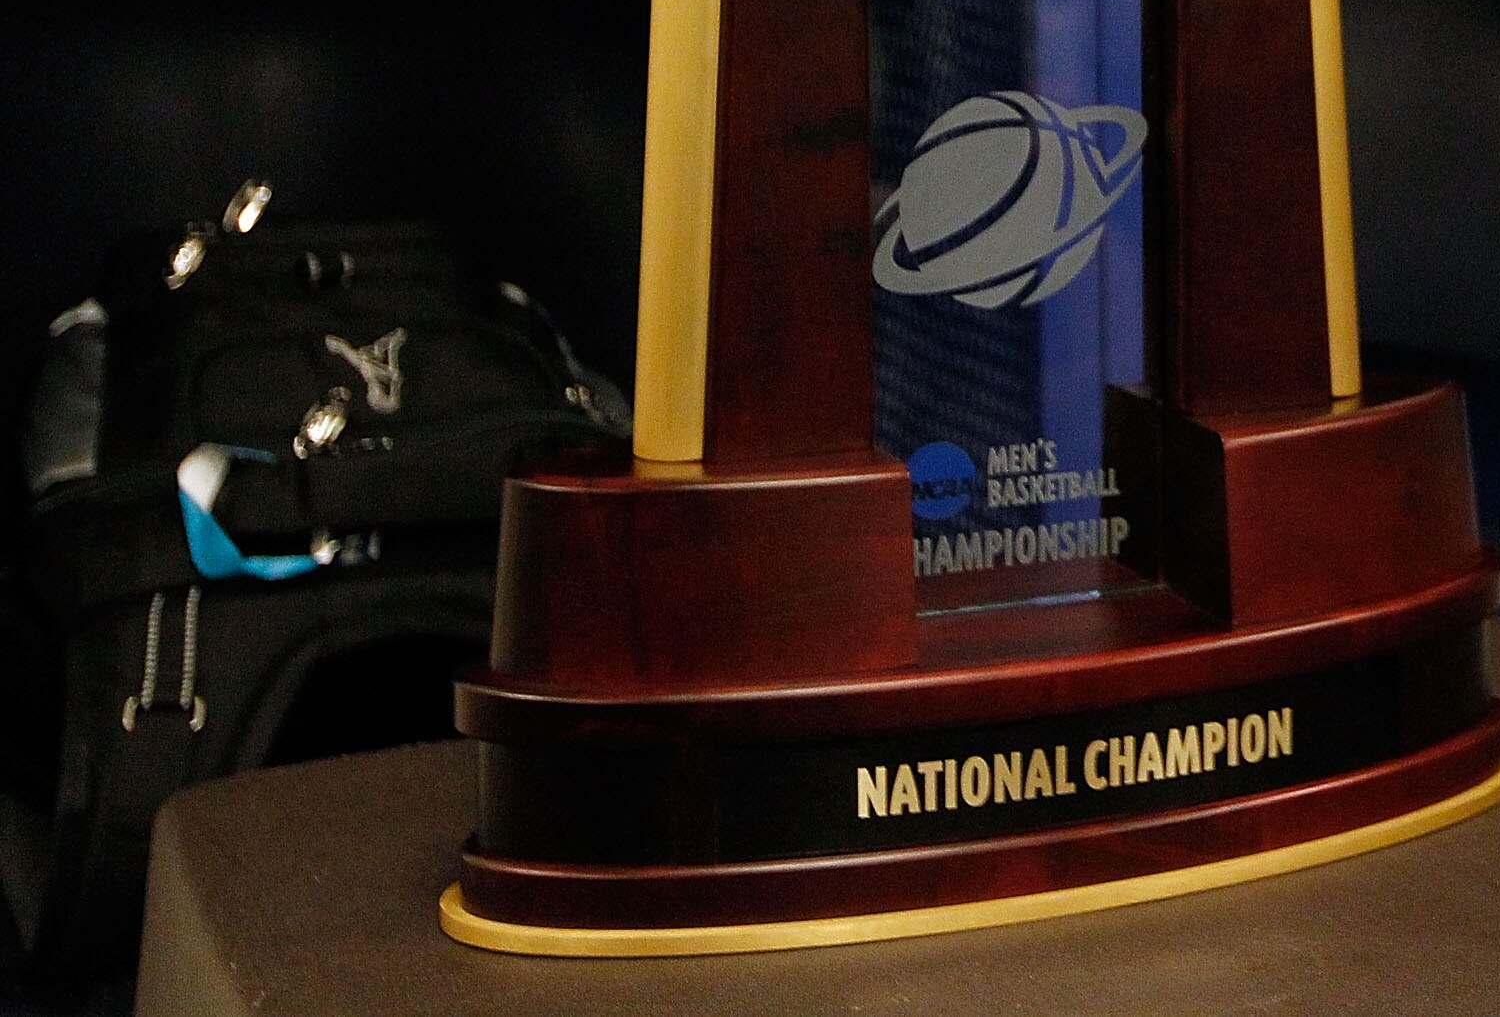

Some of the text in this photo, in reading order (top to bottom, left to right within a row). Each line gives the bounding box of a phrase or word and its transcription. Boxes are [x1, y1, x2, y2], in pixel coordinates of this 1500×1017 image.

[987, 438, 1057, 476] MEN'S
[987, 468, 1121, 508] BASKETBALL
[913, 516, 1131, 577] HAMPIONSHIP
[857, 707, 1294, 819] NATIONAL CHAMPION
